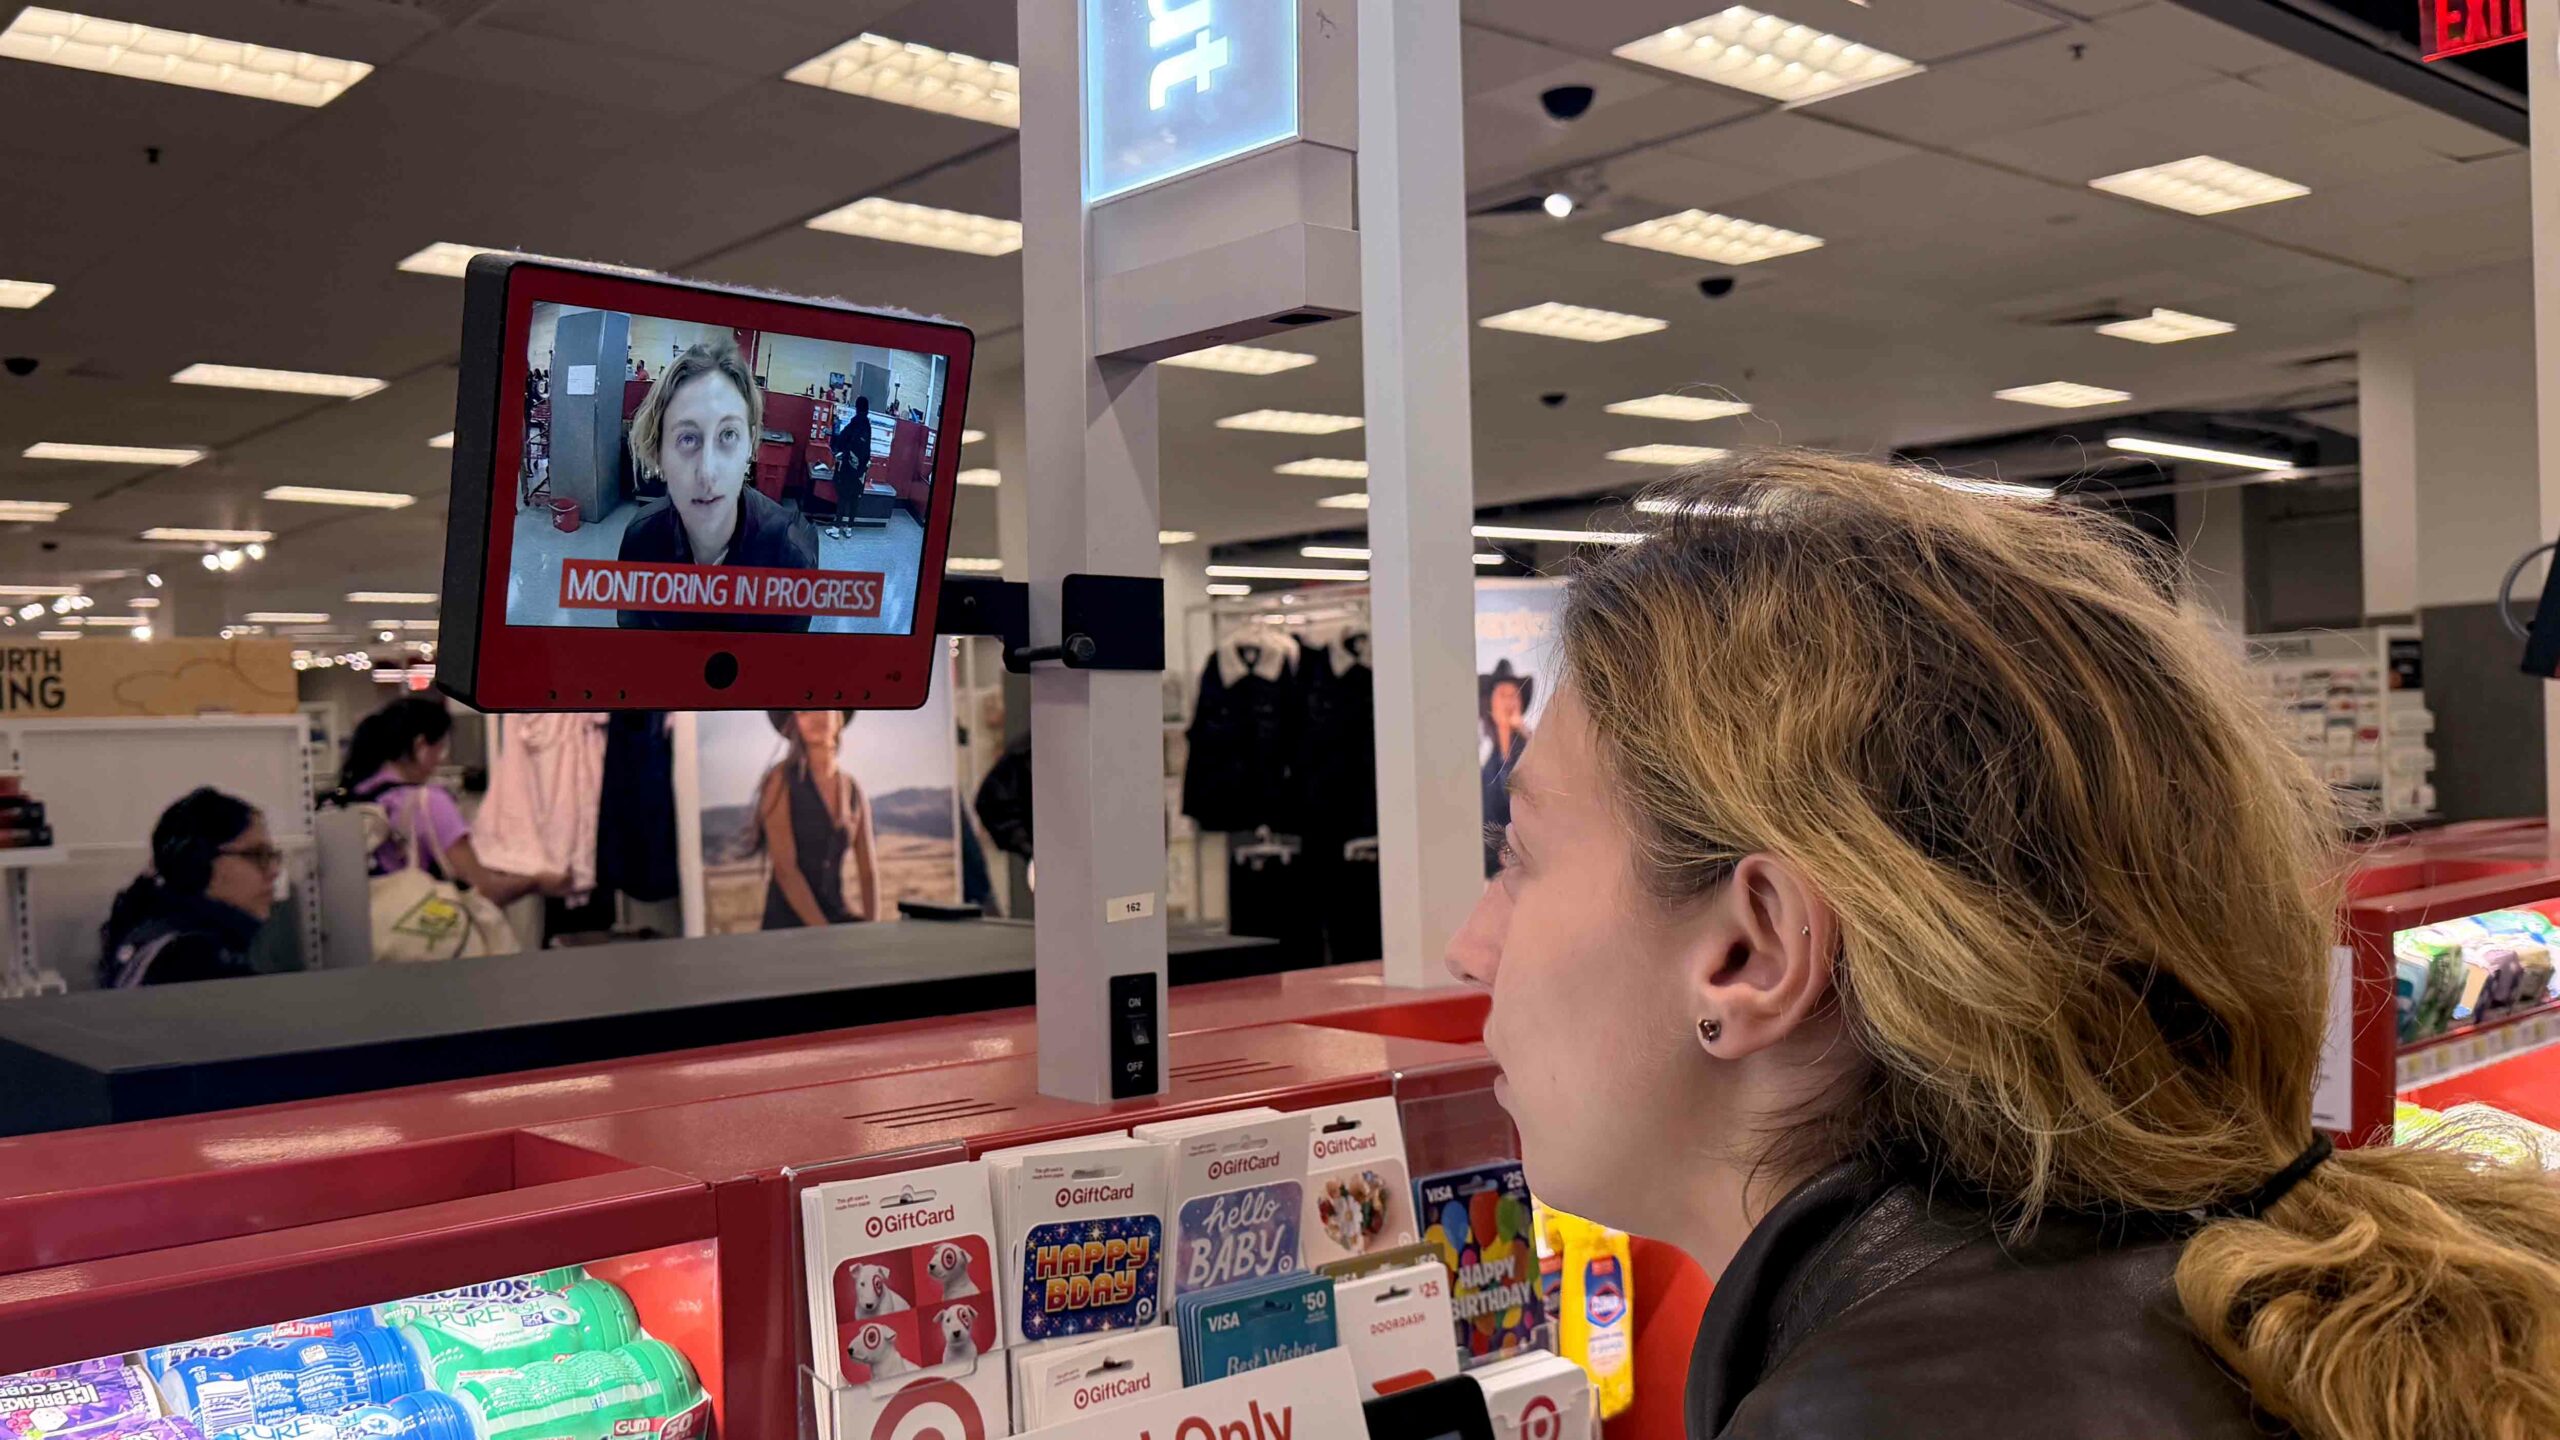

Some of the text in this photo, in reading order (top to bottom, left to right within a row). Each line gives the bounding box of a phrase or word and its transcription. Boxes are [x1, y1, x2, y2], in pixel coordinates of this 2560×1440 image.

[566, 566, 876, 612] MONITORING IN PROGRESS
[1126, 903, 1142, 913] 162
[1128, 998, 1142, 1008] ON
[1126, 1061, 1144, 1073] OFF
[1327, 1133, 1377, 1155] GiftCard
[1223, 1152, 1280, 1176] GiftCard
[1072, 1183, 1134, 1205] GiftCard
[1425, 1185, 1454, 1203] VISA
[884, 1205, 955, 1234] GiftCard
[1202, 1191, 1279, 1235] hello
[1036, 1235, 1151, 1281] HAPPY
[1187, 1224, 1286, 1288] BABY
[1458, 1256, 1516, 1289] HAPPY
[1045, 1268, 1138, 1313] BDAY
[1302, 1290, 1327, 1312] $50
[1419, 1281, 1439, 1299] $25
[1451, 1282, 1533, 1322] BIRTHDAY
[434, 1306, 504, 1328] PURE
[1207, 1311, 1241, 1333] VISA
[1370, 1312, 1427, 1336] DOORDASH
[1226, 1354, 1261, 1377] Best
[1090, 1373, 1151, 1403] GiftCard
[665, 1413, 694, 1440] 50
